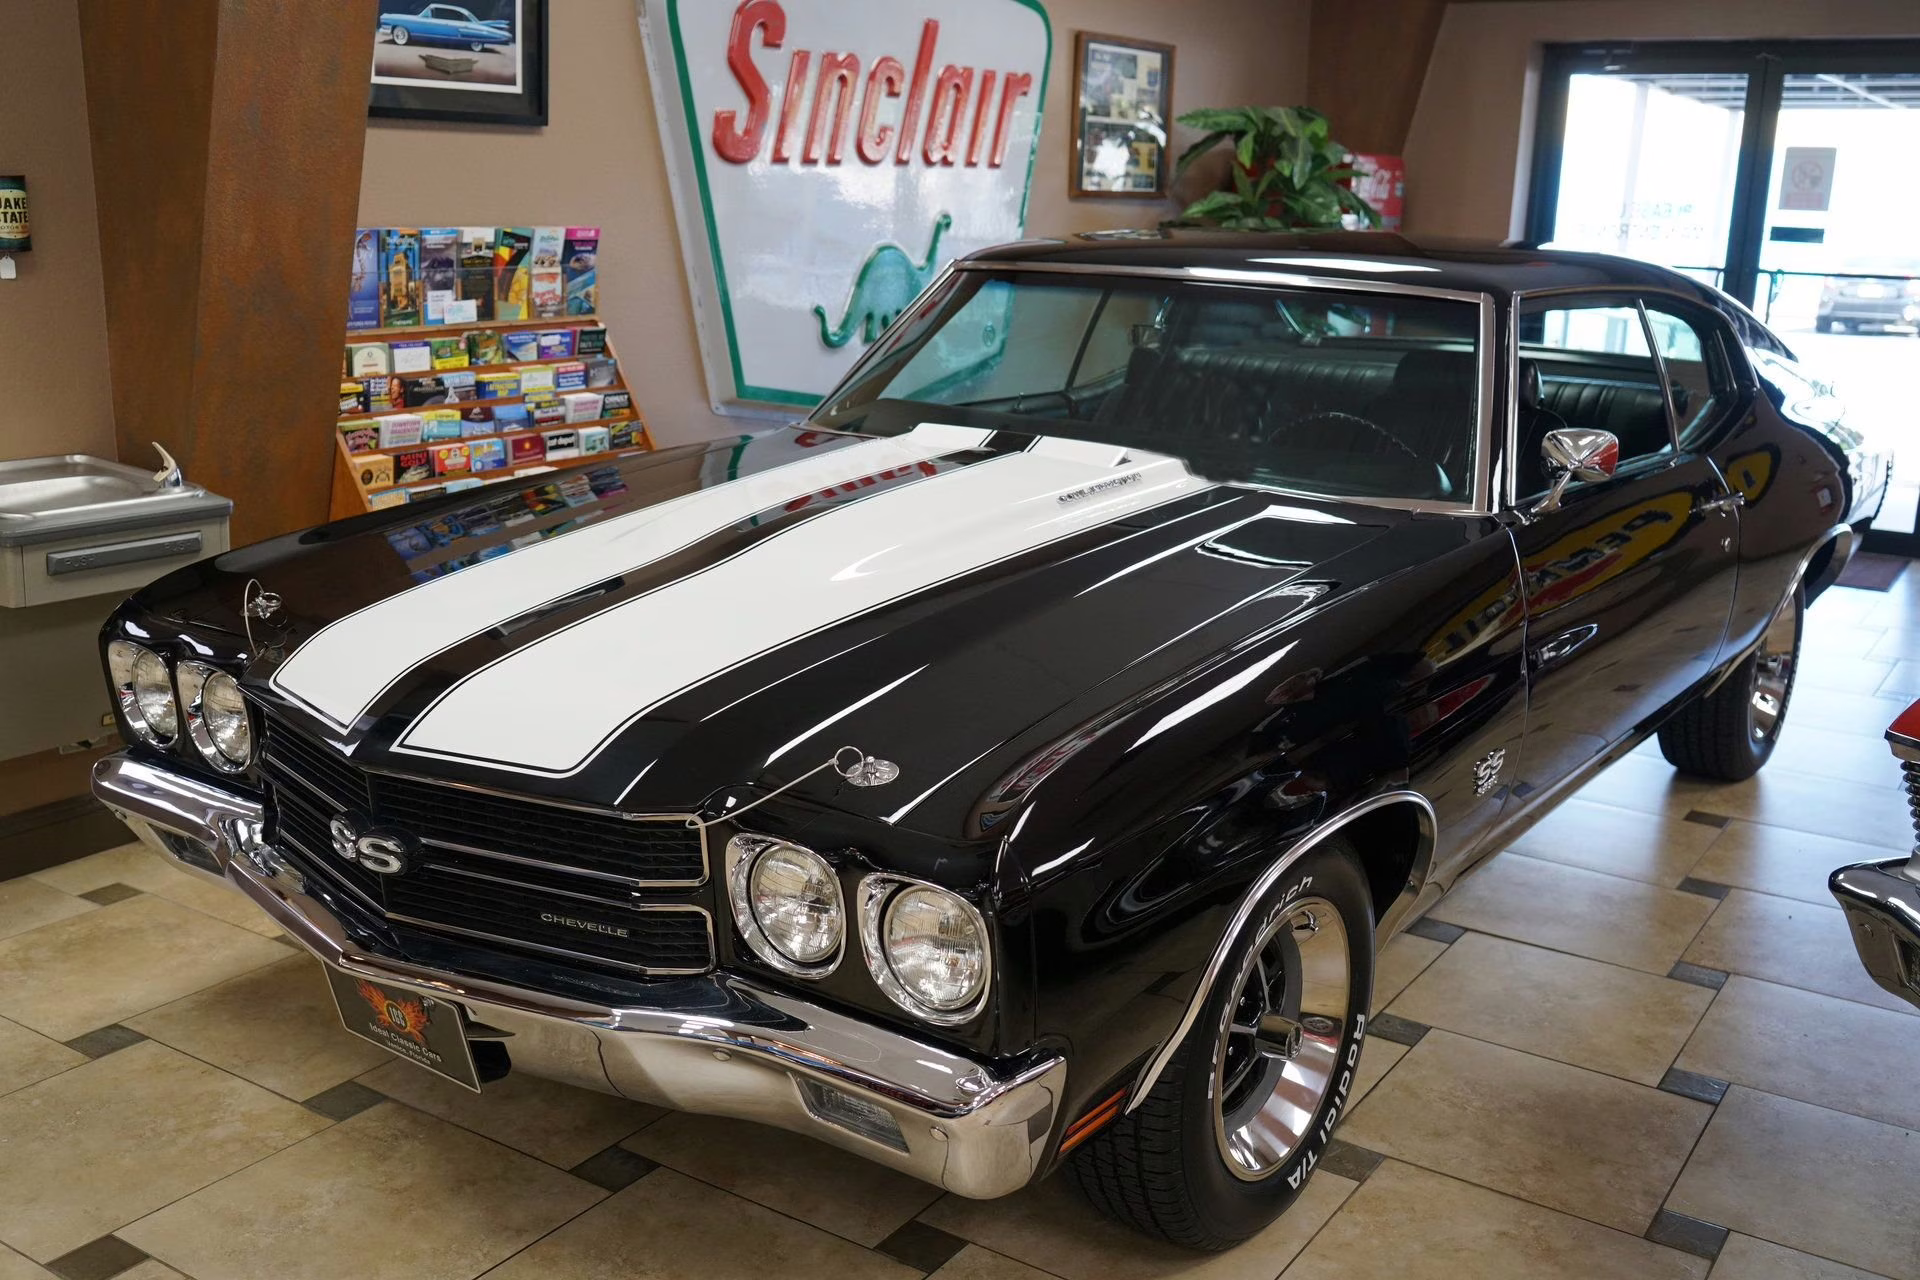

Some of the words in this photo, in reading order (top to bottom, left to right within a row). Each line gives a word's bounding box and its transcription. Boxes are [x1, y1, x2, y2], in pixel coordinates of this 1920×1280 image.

[712, 0, 1032, 169] Sinclair
[0, 197, 27, 210] AKE
[0, 211, 29, 223] TATE
[1475, 748, 1506, 787] SS
[329, 817, 403, 875] SS
[540, 912, 629, 938] CHEVELLE
[369, 1022, 390, 1038] Ideal
[390, 1032, 422, 1052] Classic
[422, 1047, 443, 1063] Cars
[1318, 1012, 1367, 1147] Radial
[1286, 1148, 1319, 1192] T/A
